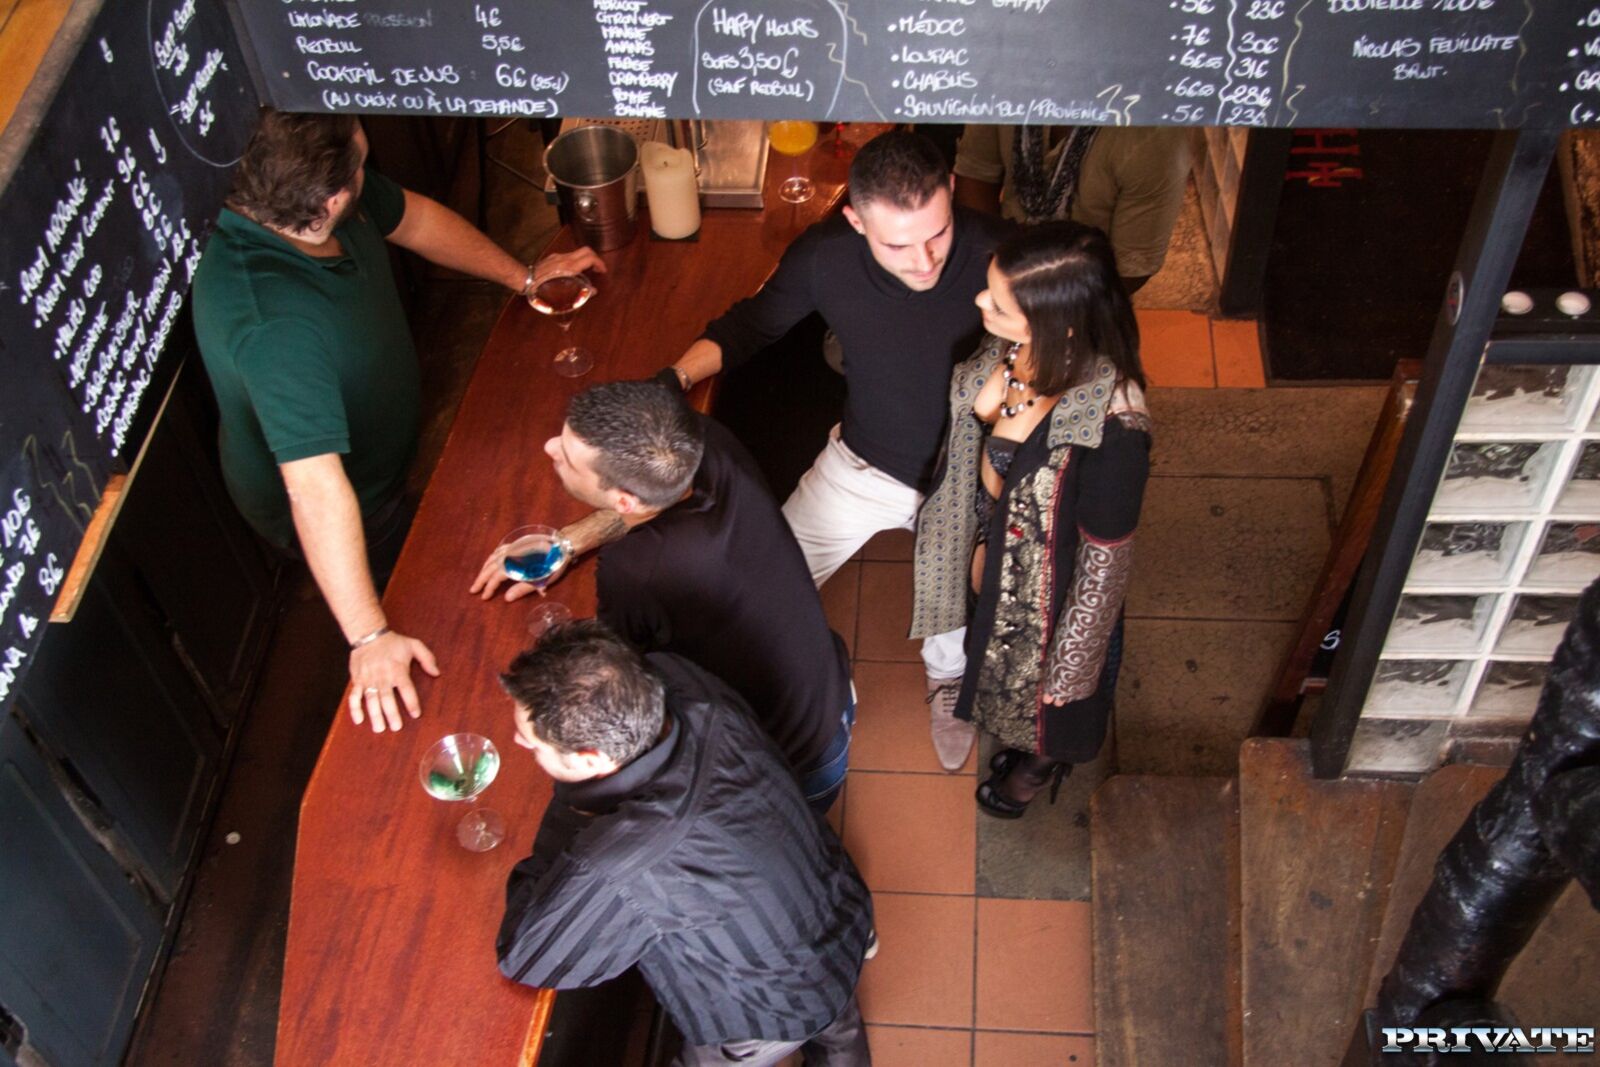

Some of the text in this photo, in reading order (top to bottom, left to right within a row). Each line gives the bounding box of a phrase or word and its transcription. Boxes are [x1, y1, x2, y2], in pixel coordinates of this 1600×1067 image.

[475, 5, 502, 28] 4€
[765, 19, 819, 38] HOURS
[899, 10, 966, 36] MÉDOC
[307, 61, 460, 86] COCKTAIL DE JUS
